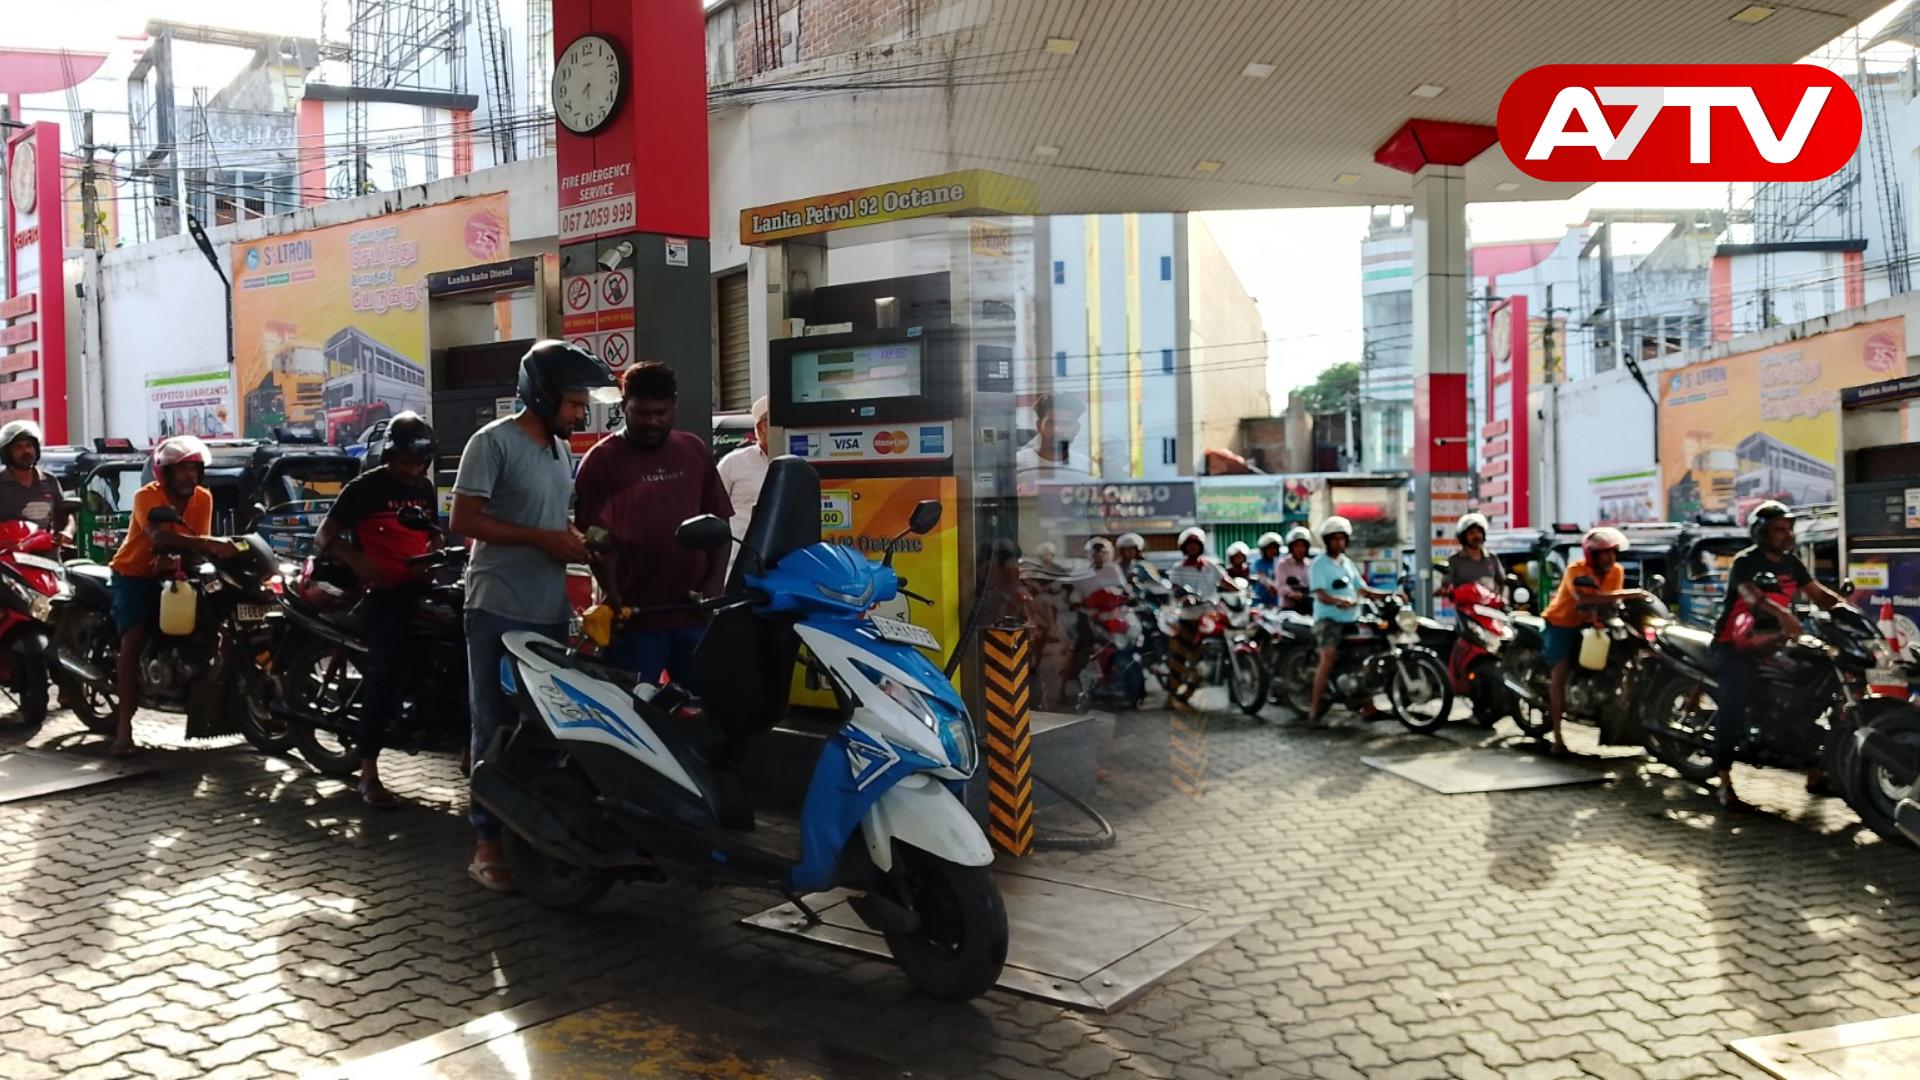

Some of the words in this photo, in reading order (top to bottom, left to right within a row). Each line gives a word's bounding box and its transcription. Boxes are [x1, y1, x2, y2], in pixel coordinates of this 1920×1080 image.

[582, 42, 592, 56] 12
[599, 44, 602, 57] 1
[571, 52, 578, 65] 11
[606, 54, 615, 68] 2
[610, 71, 617, 84] 3
[560, 85, 567, 99] 9
[564, 101, 572, 113] 8
[598, 105, 606, 118] 5
[585, 113, 594, 127] 6
[561, 174, 580, 190] FIRE
[580, 162, 632, 184] EMERGENCY
[579, 183, 614, 200] SERVICE
[752, 209, 801, 234] Lanka
[805, 200, 856, 226] Petrol
[859, 196, 878, 217] 92
[883, 183, 965, 212] Octane
[562, 212, 582, 233] 067
[583, 206, 609, 229] 2059
[612, 201, 633, 223] 999
[447, 274, 470, 285] Lanka
[471, 271, 489, 282] Auto
[489, 266, 513, 279] Diesel
[833, 438, 859, 450] VISA
[1060, 484, 1170, 504] COLOMBO
